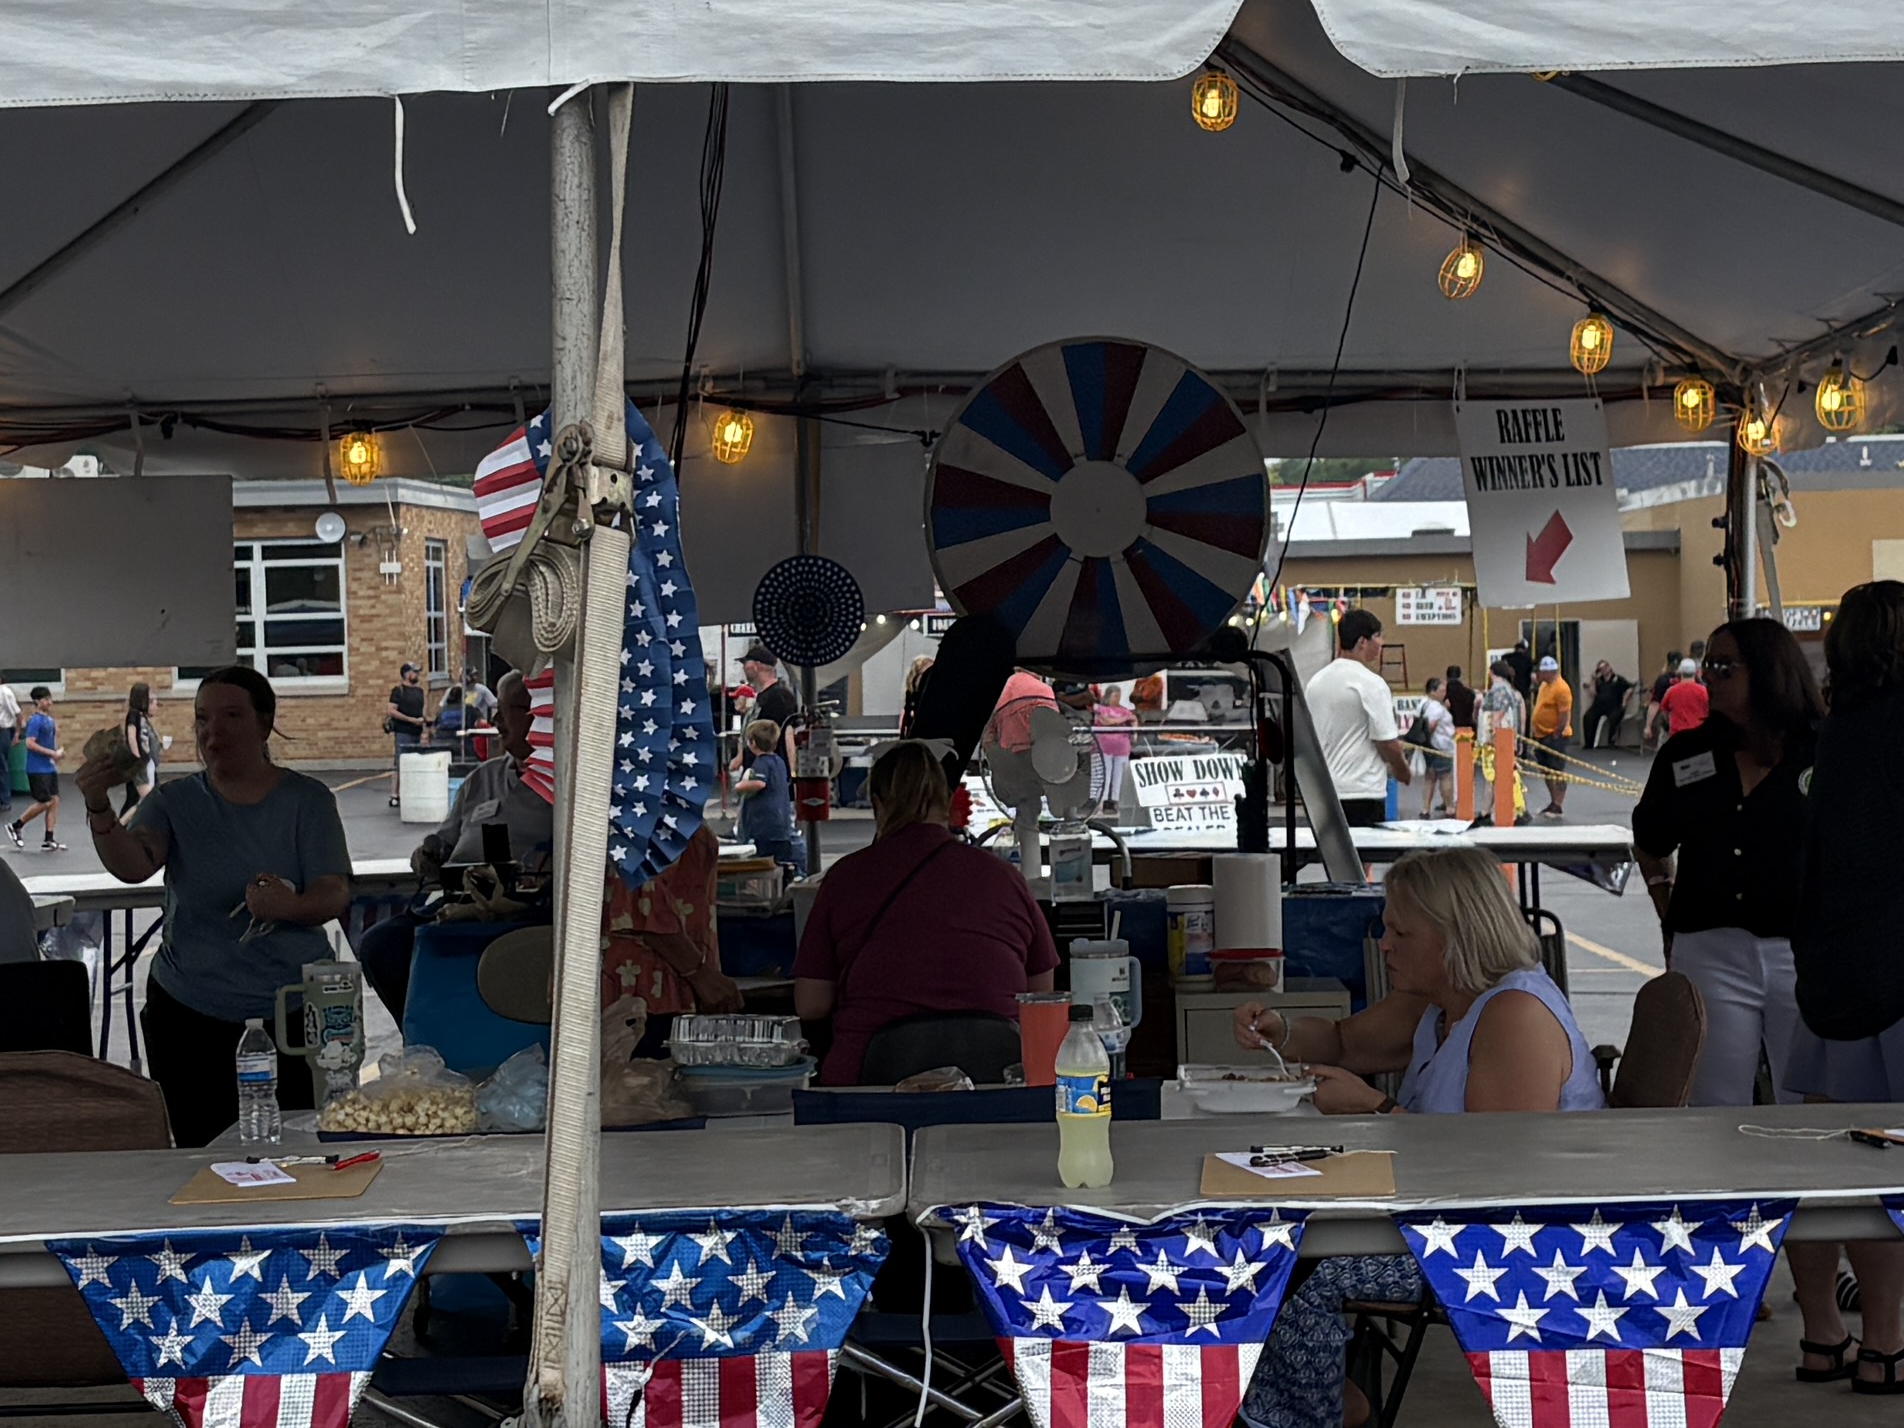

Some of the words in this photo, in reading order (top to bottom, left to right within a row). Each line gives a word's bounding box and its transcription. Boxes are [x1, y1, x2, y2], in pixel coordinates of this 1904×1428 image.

[1496, 408, 1565, 443] RAFFLE
[1470, 453, 1559, 492] WINNER'S
[1562, 451, 1602, 487] LIST
[1135, 759, 1184, 788] SHOW
[1192, 756, 1244, 781] DOWN
[1153, 806, 1194, 823] BEAT
[1199, 805, 1231, 821] THE
